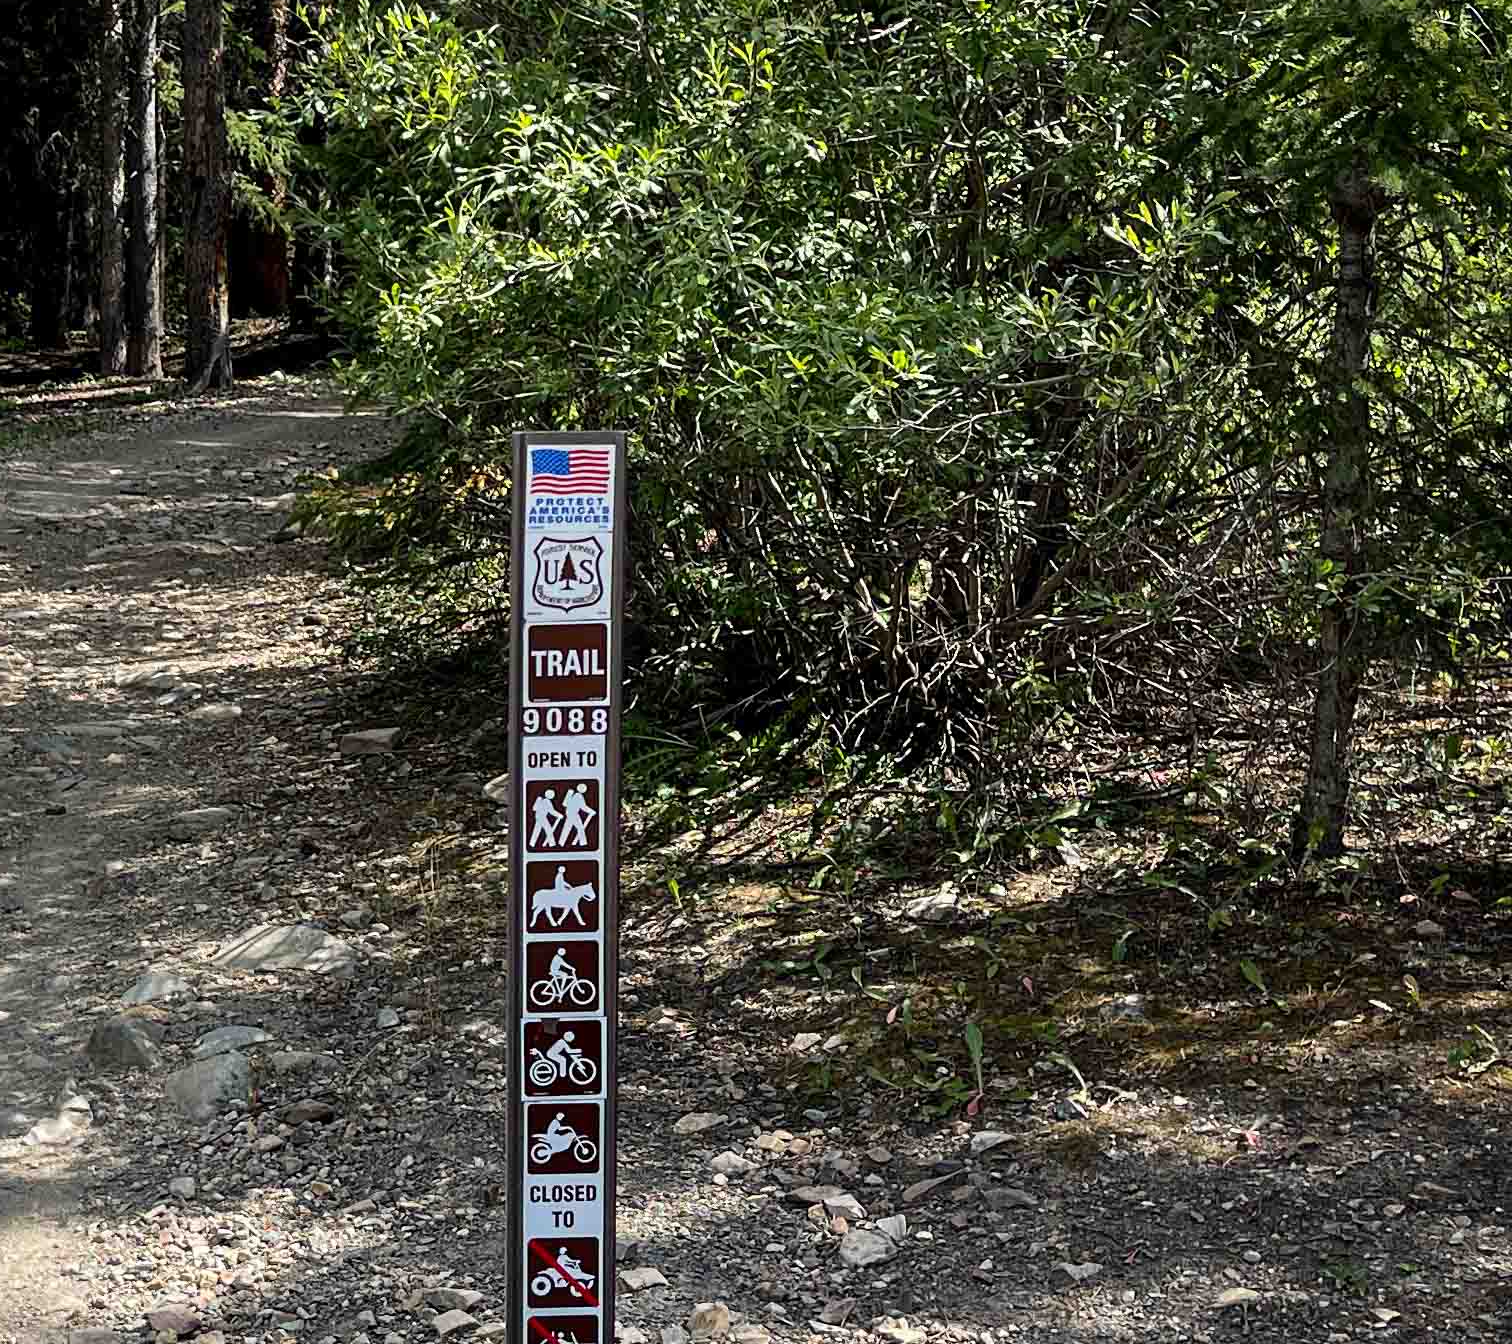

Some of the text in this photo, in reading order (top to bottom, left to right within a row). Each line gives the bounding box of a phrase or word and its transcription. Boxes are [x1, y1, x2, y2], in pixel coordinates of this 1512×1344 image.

[529, 506, 609, 515] AMERICA'S
[536, 498, 604, 506] PROTECT
[529, 515, 609, 524] RESOURCES
[531, 649, 605, 677] TRAIL
[523, 708, 608, 733] 9088
[528, 751, 597, 768] OPEN TO
[530, 1184, 597, 1203] CLOSED
[552, 1210, 575, 1228] TO
